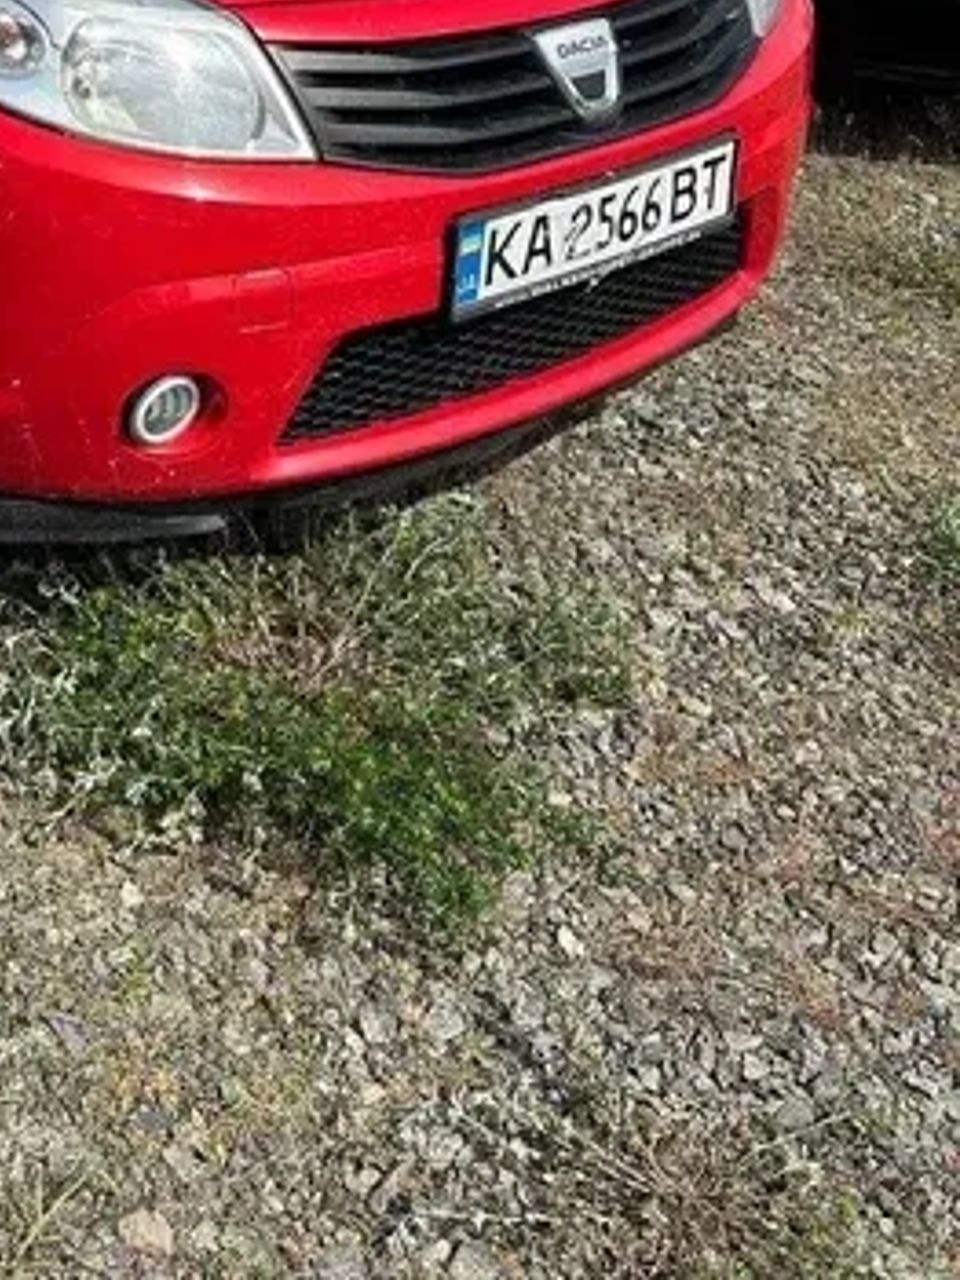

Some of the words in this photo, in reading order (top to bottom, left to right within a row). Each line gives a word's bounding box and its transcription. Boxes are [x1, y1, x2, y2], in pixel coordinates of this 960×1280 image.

[484, 213, 552, 287] KA
[563, 178, 662, 262] 2566
[669, 153, 727, 224] BT
